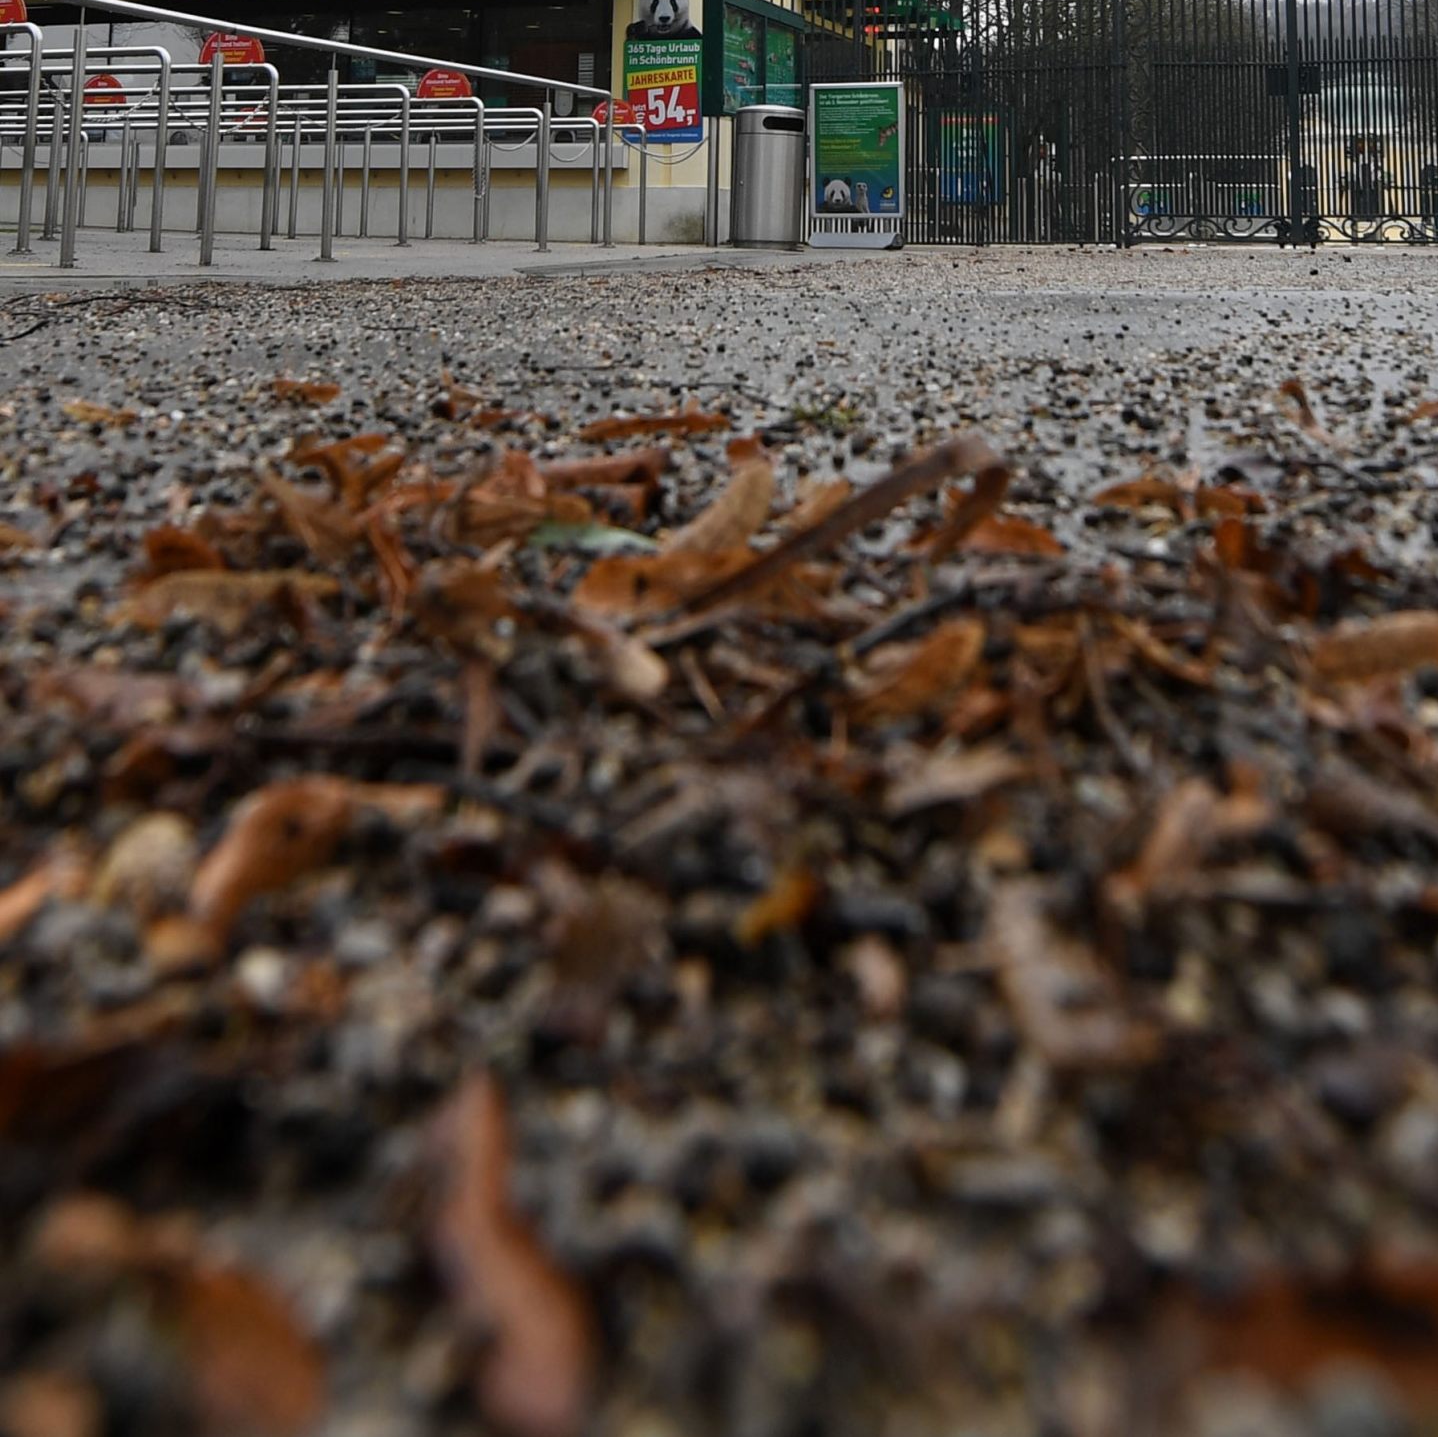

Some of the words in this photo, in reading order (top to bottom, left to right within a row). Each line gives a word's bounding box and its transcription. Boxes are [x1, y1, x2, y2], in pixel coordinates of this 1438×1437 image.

[628, 44, 644, 54] 365
[646, 43, 667, 54] Tage
[669, 43, 700, 53] Urlaub
[629, 56, 638, 65] in
[639, 55, 698, 65] Schönbrunn!
[630, 69, 694, 86] JAHRESKARTE
